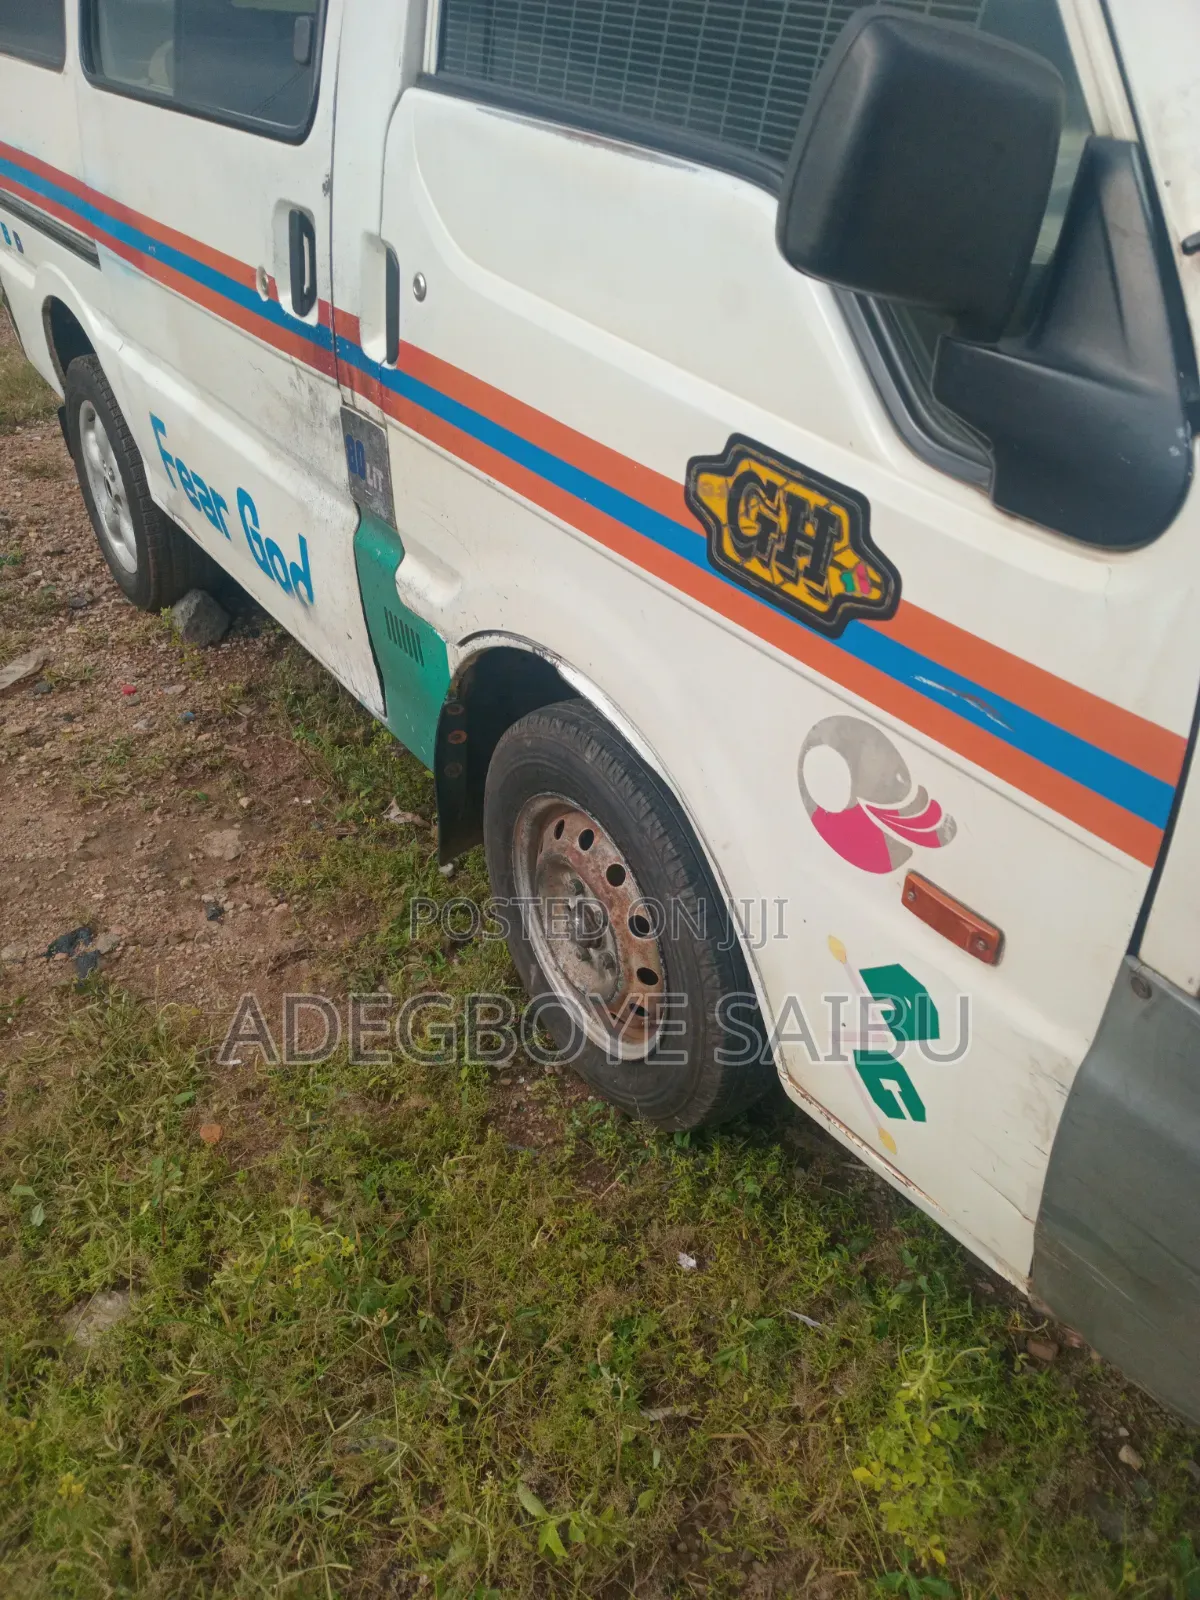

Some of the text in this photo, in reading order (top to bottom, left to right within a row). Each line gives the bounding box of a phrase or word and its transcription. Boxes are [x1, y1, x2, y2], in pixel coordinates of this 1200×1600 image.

[149, 411, 315, 608] Fear God
[726, 470, 843, 594] GH
